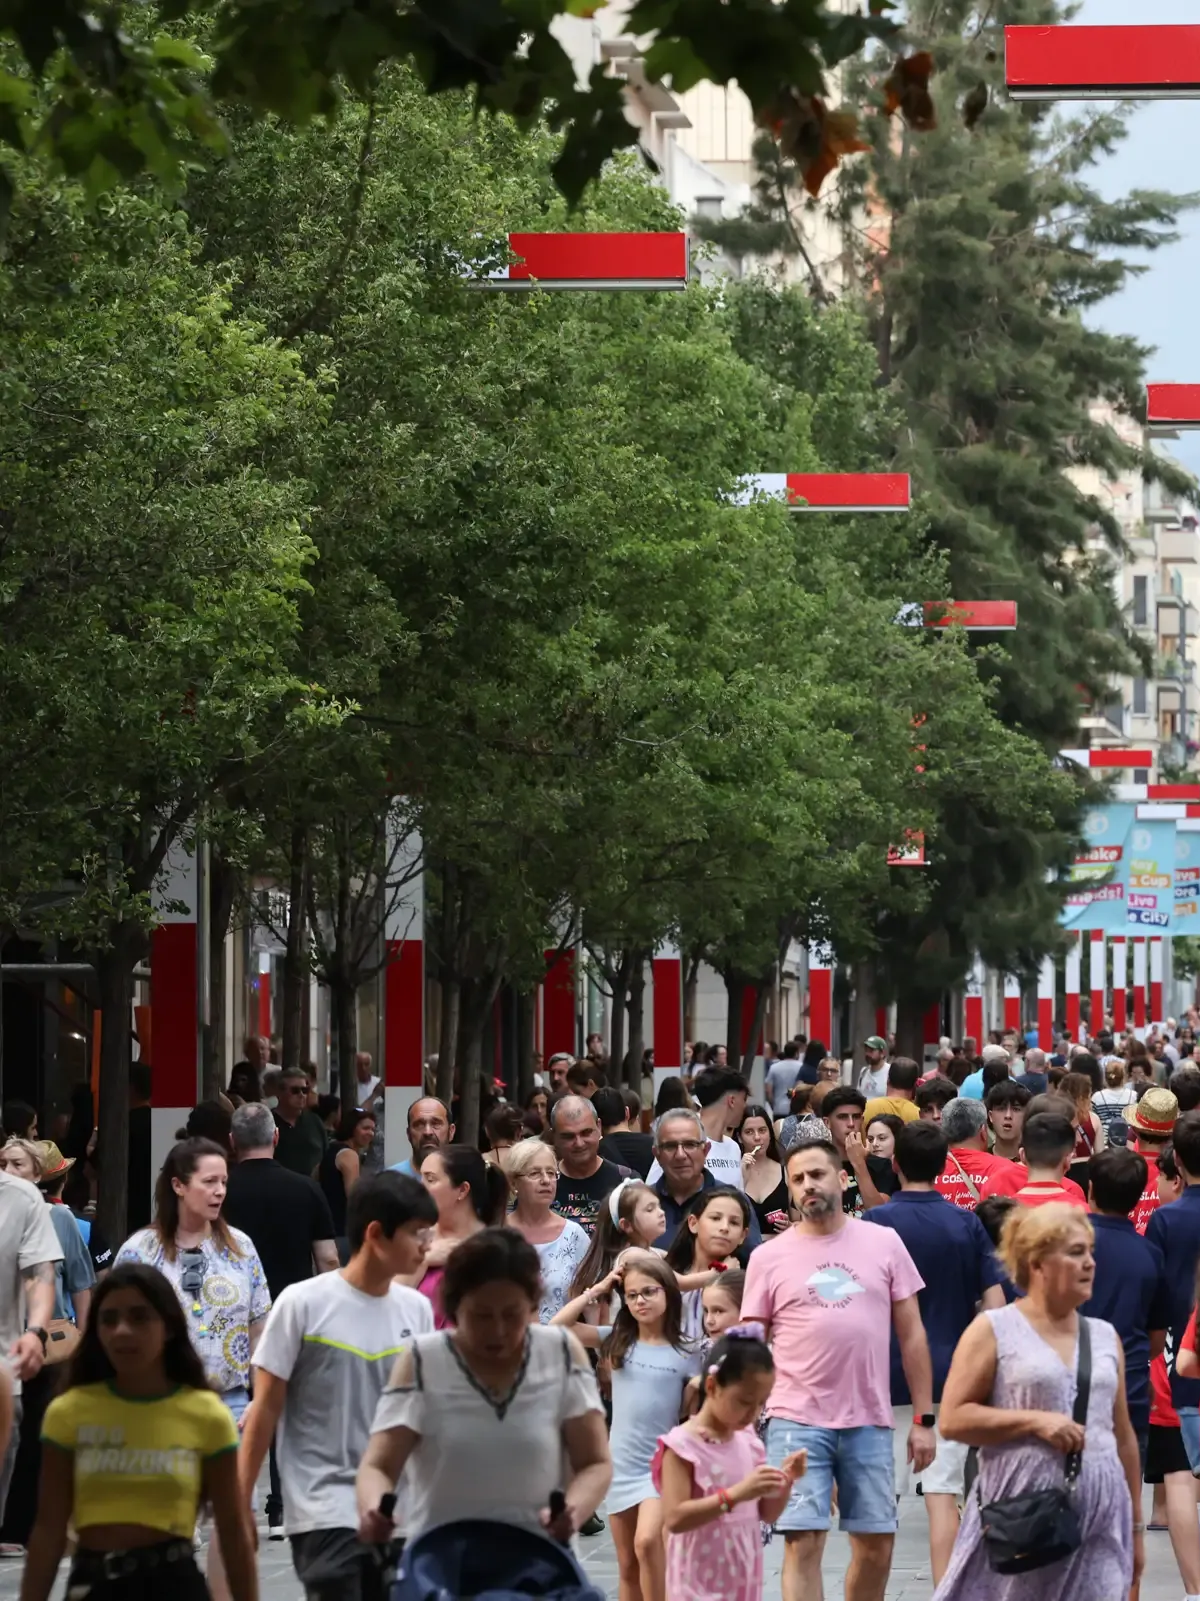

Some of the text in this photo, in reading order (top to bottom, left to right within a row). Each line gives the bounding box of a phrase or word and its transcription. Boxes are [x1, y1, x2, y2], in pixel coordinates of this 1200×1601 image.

[1141, 874, 1168, 889] Cup
[1175, 889, 1197, 898] ore
[1141, 911, 1168, 925] City
